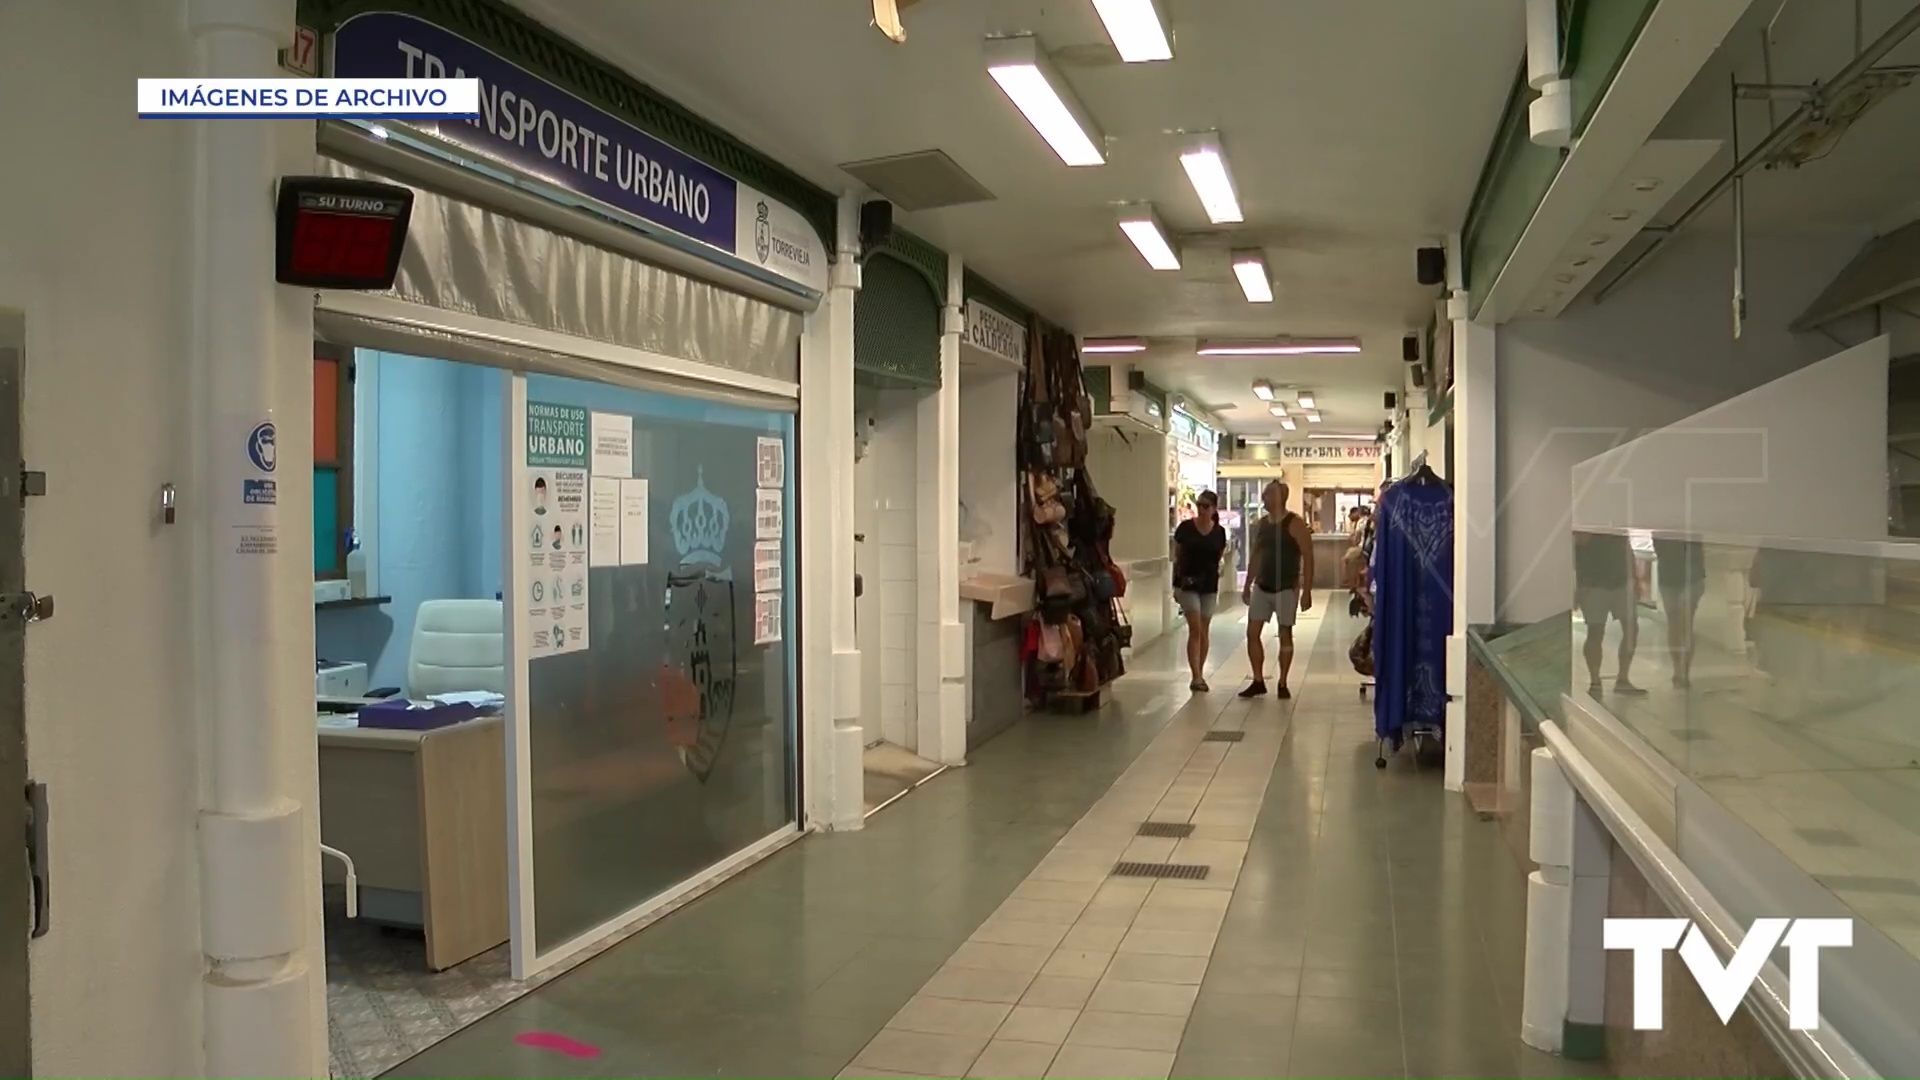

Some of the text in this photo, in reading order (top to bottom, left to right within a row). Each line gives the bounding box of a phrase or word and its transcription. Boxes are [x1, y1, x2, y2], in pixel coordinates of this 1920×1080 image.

[616, 143, 710, 225] URBANO
[317, 196, 384, 212] SU TURNO
[771, 236, 810, 267] TORREVIEJA
[528, 404, 585, 421] NORMAS DE USO
[528, 416, 585, 438] TRANSPORTE
[528, 435, 585, 456] URBANO
